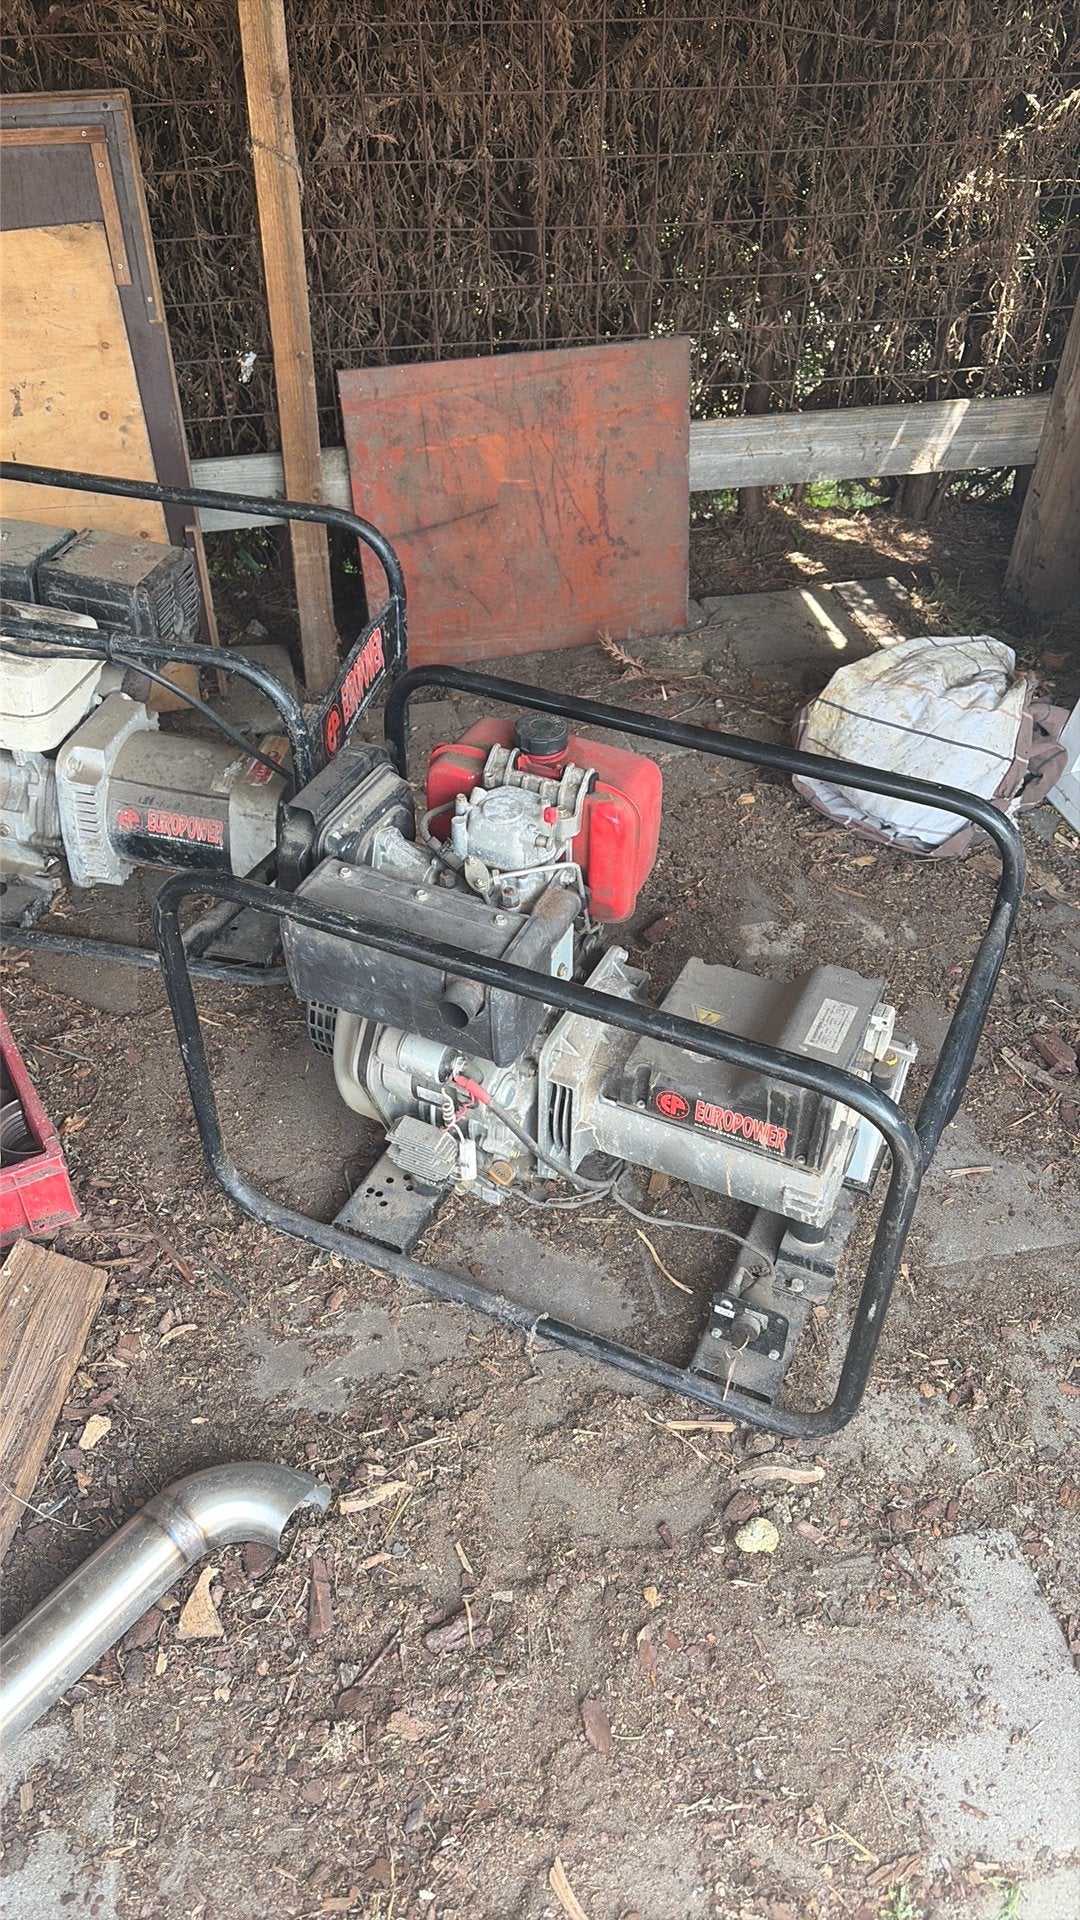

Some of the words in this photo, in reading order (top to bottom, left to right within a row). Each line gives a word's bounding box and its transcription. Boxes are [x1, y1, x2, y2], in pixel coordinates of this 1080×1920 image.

[341, 626, 385, 726] EUROPOWER
[147, 808, 224, 846] EUROPOWER
[660, 1094, 686, 1115] EP
[694, 1099, 788, 1152] EUROPOWER
